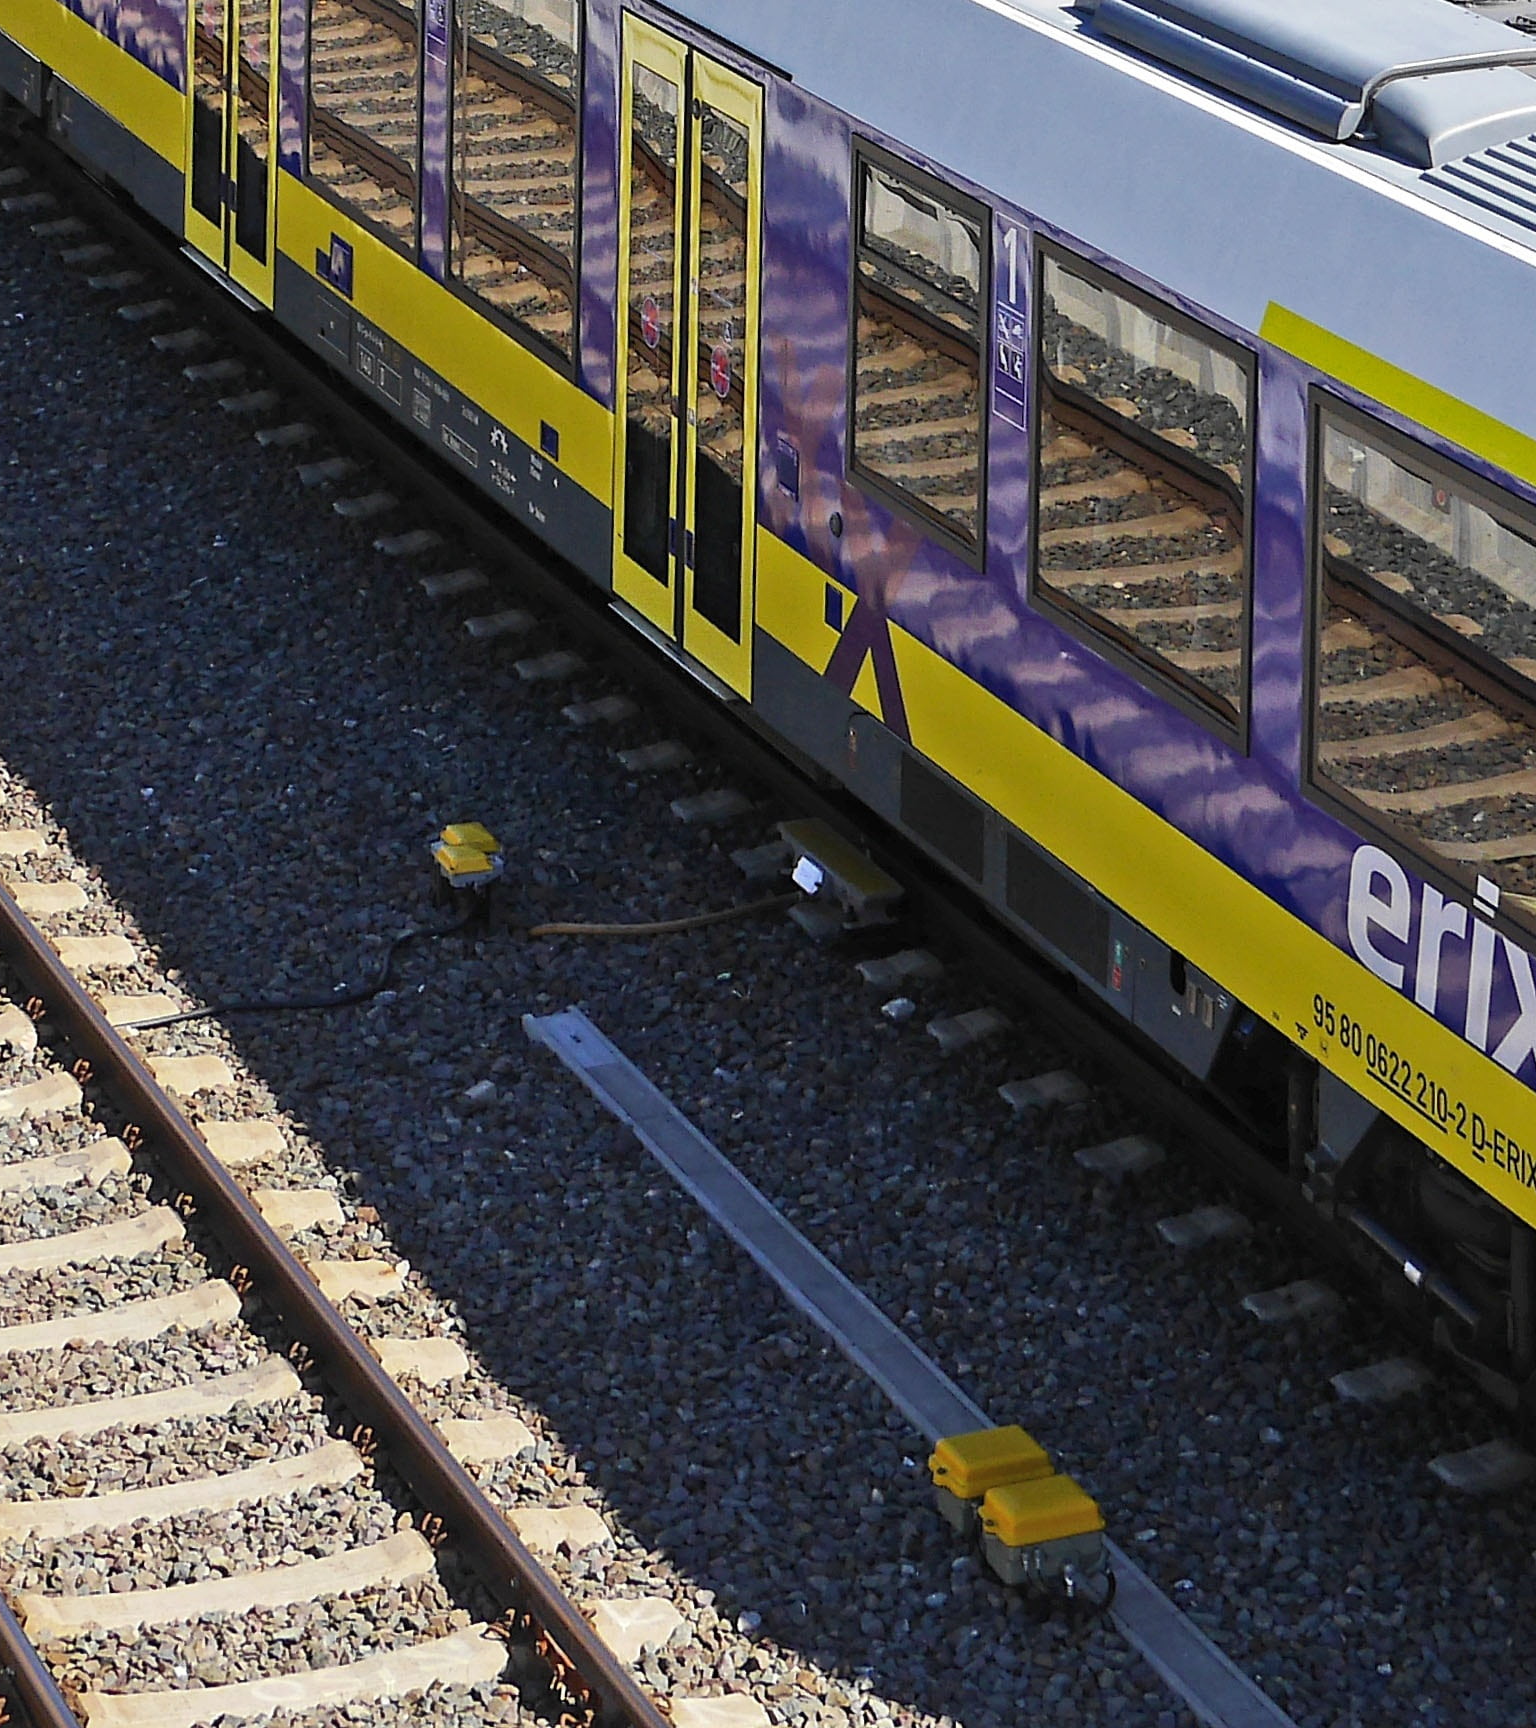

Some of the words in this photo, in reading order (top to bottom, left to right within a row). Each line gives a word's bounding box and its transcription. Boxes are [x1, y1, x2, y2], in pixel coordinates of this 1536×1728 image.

[1002, 227, 1017, 305] 1
[1312, 993, 1336, 1038] 95
[1339, 1013, 1363, 1058] 80
[1365, 1033, 1413, 1098] 0622
[1416, 1072, 1468, 1139] 210-2
